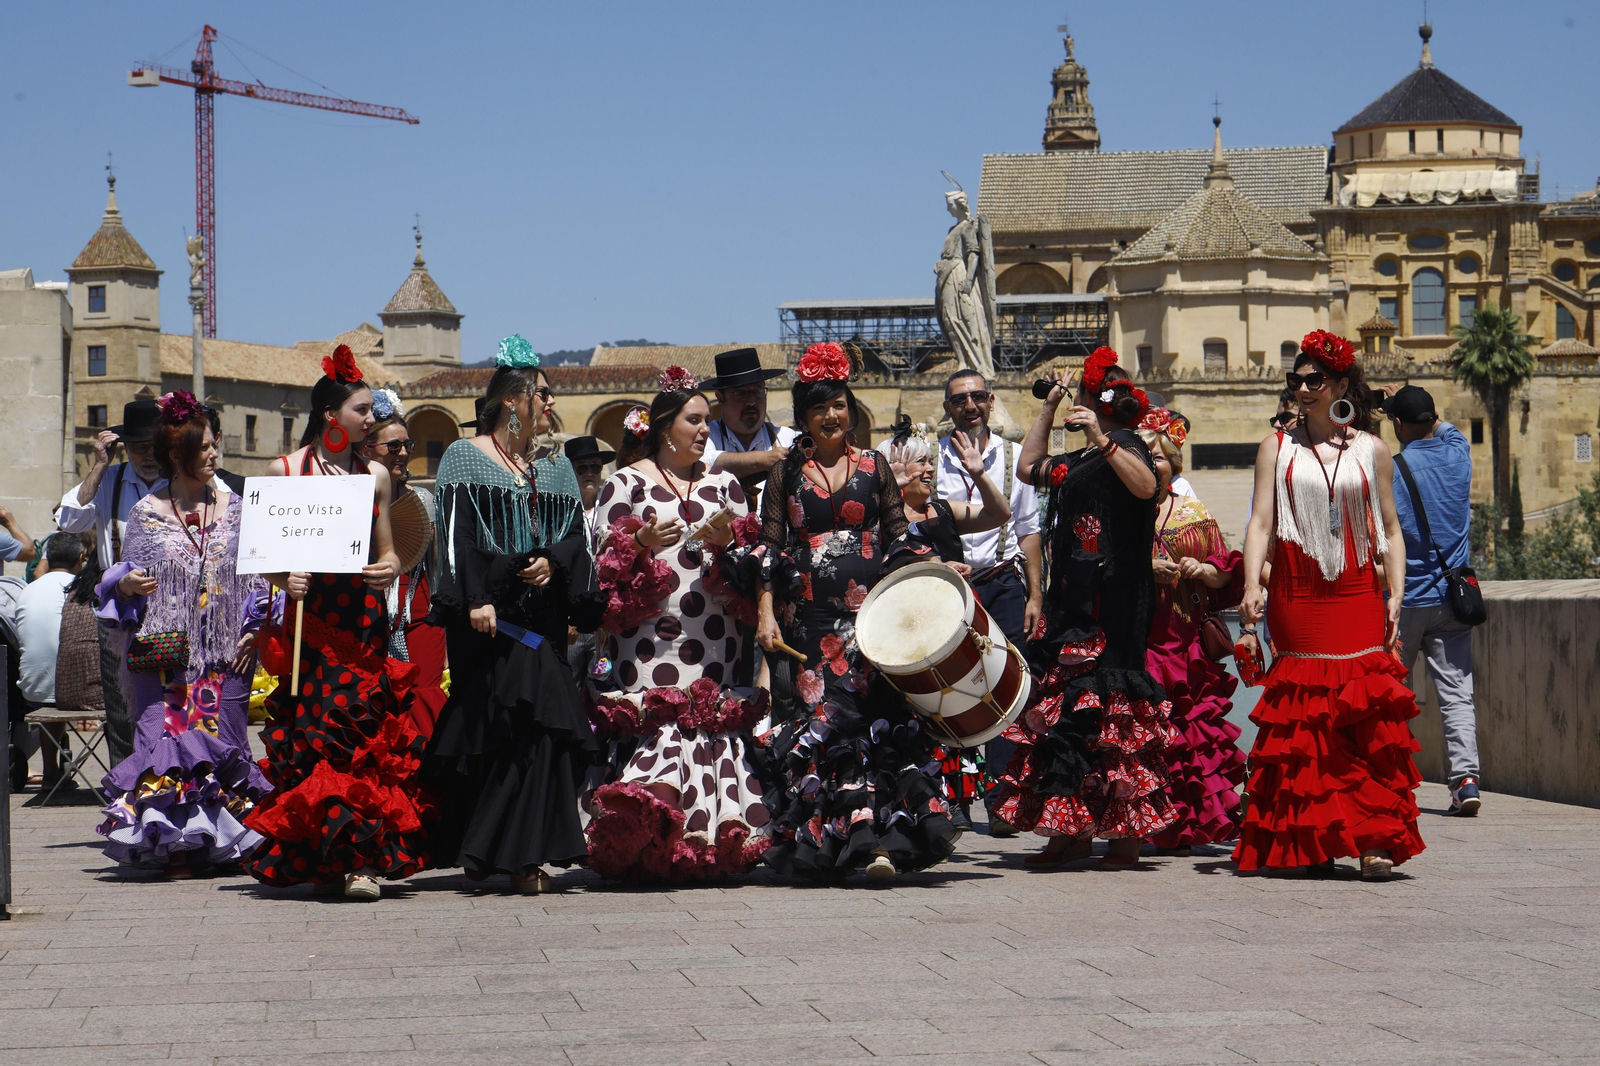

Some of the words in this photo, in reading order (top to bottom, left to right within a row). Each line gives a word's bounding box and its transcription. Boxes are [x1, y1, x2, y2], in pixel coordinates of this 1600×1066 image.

[249, 490, 260, 505] 11
[268, 505, 301, 516] Coro
[307, 504, 343, 515] Vista
[281, 526, 324, 538] Sierra
[350, 540, 361, 555] 11
